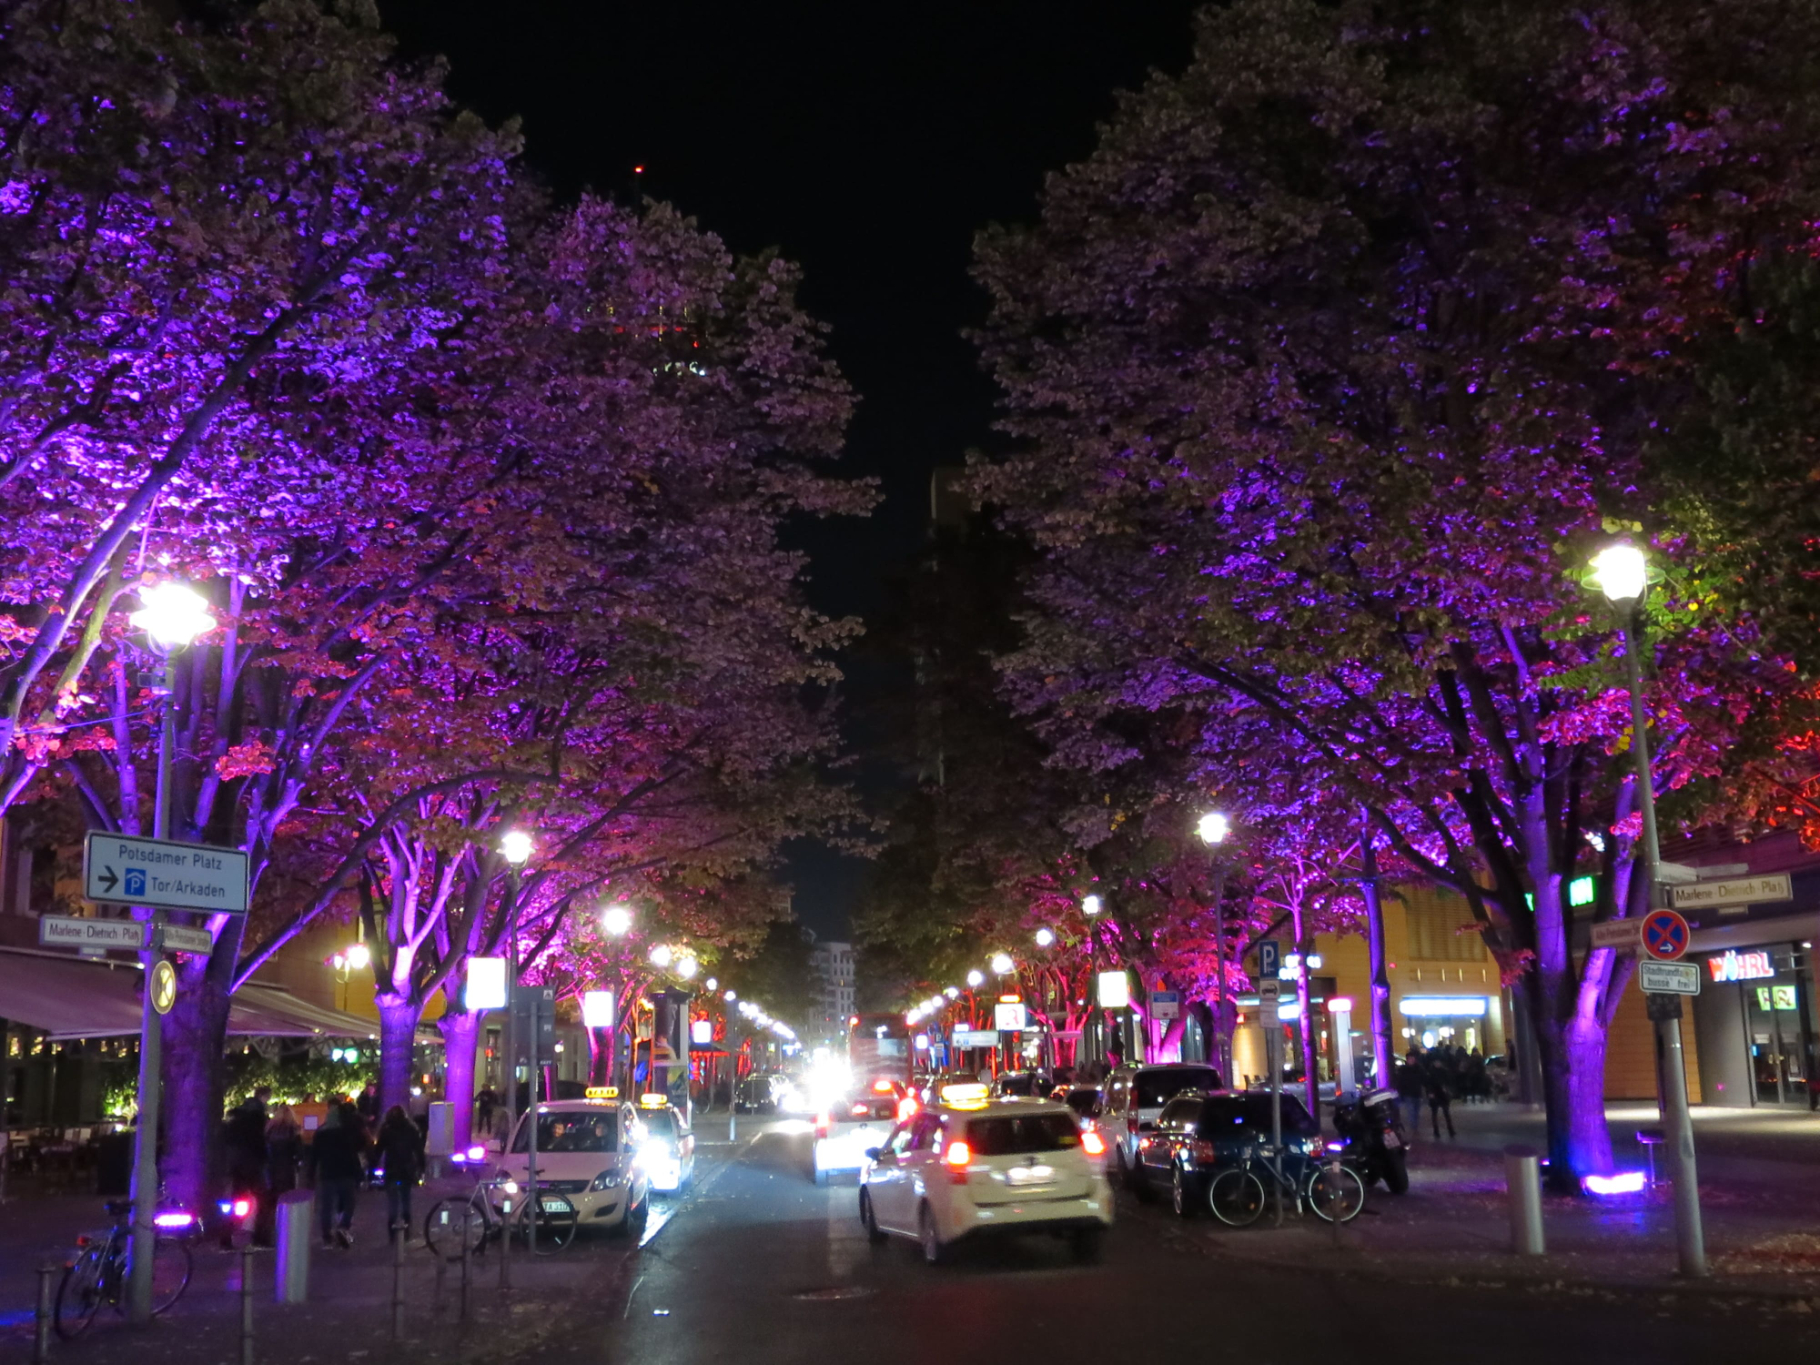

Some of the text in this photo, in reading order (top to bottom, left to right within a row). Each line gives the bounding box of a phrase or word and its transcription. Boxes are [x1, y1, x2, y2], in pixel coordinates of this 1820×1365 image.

[118, 844, 222, 871] Potsdamer Platz
[131, 877, 141, 893] P
[151, 876, 225, 898] Tor/Arkaden
[1263, 945, 1275, 974] P
[1708, 949, 1775, 982] WÖHRL
[1647, 977, 1691, 989] busse frei
